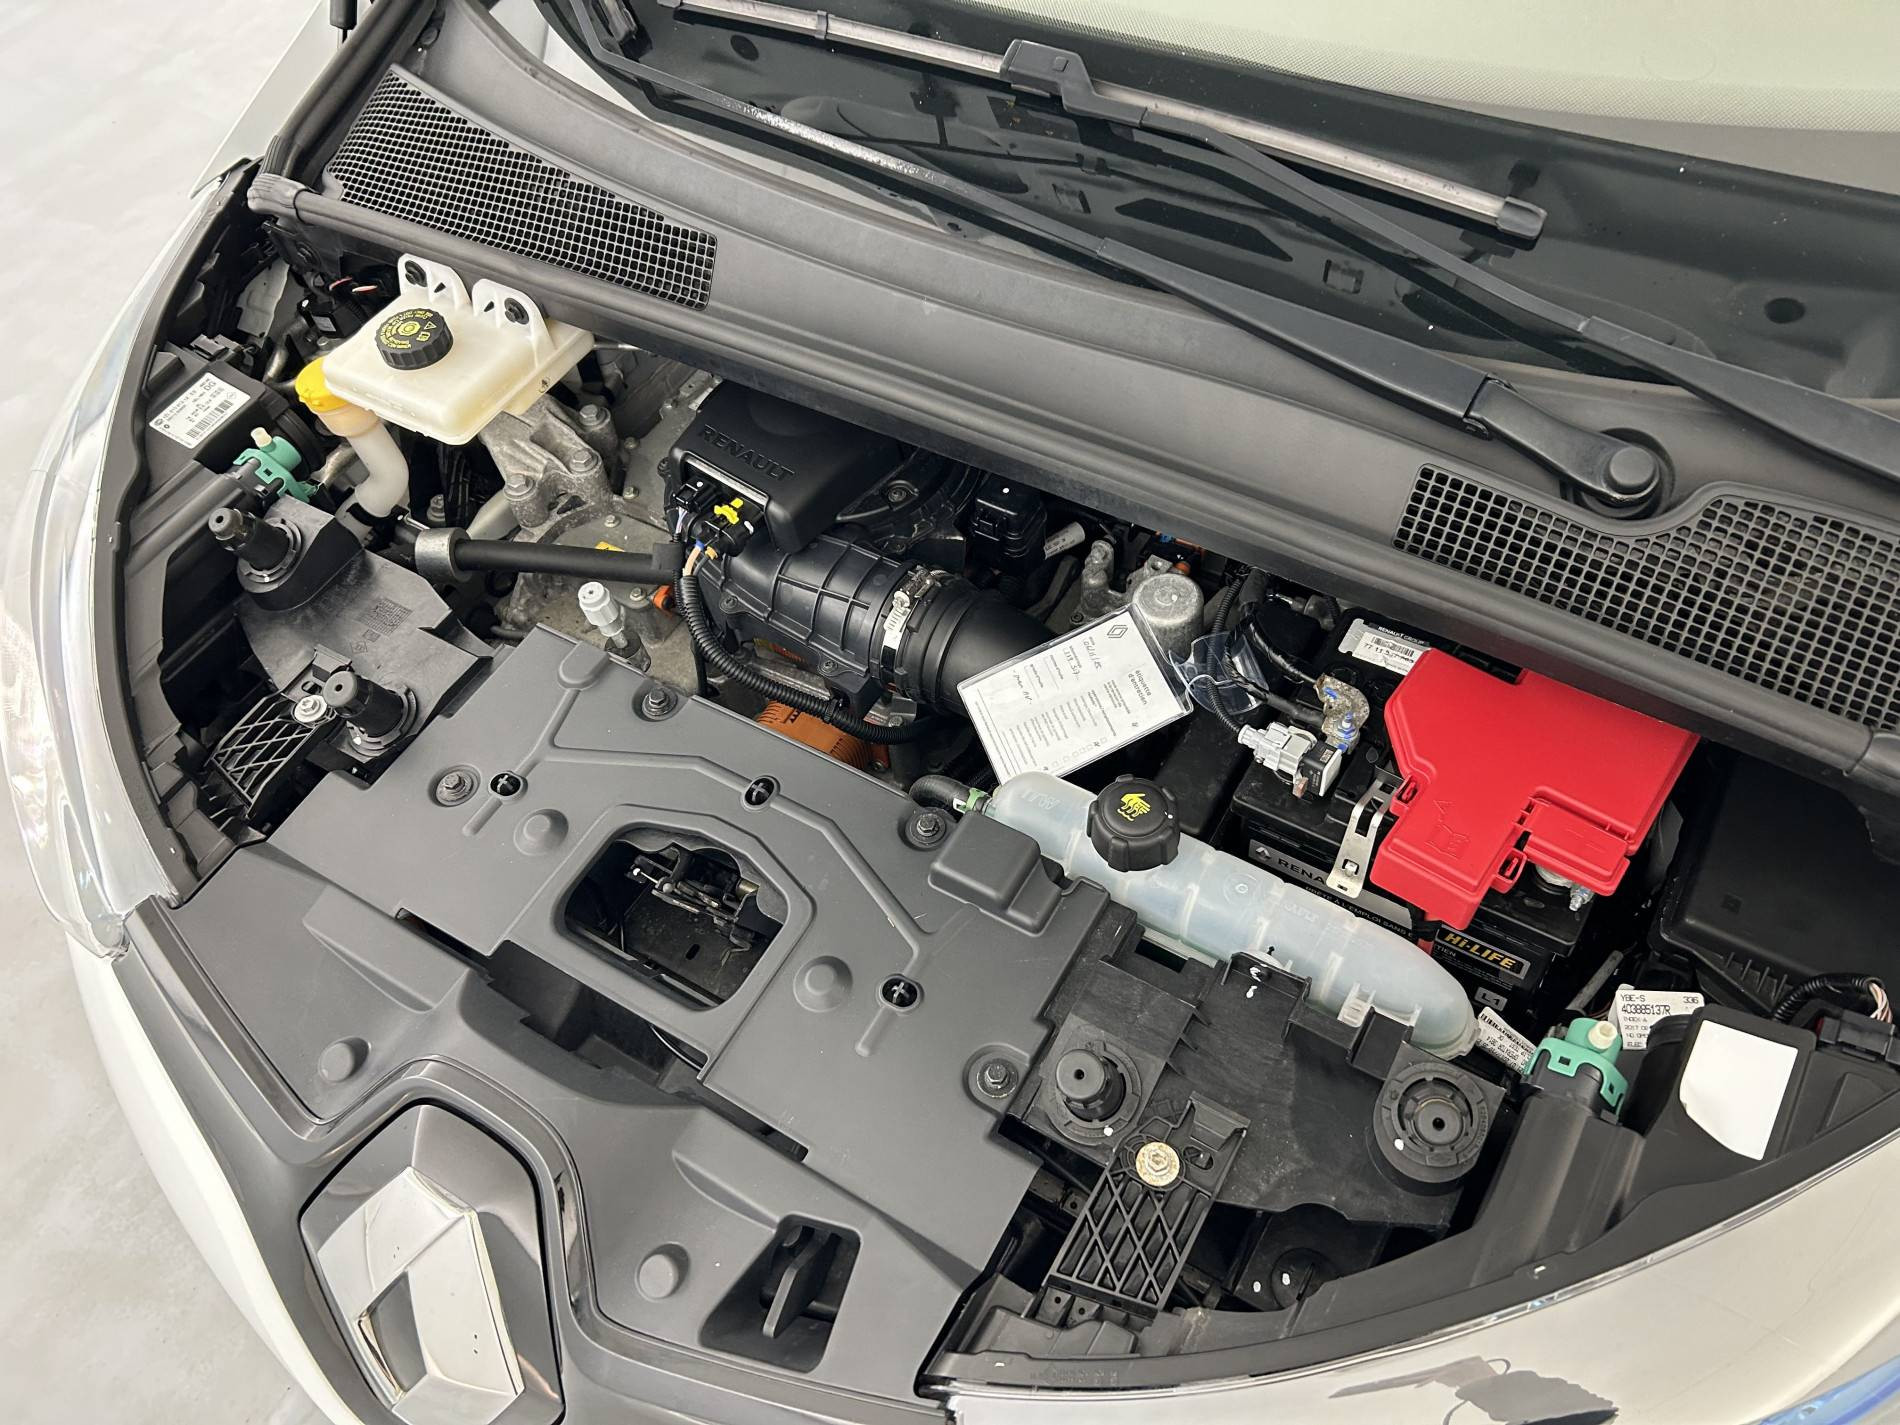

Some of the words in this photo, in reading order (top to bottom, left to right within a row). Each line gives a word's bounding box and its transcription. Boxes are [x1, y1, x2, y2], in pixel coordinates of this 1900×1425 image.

[699, 424, 795, 480] RENAULT
[1276, 858, 1326, 885] RENA
[1443, 932, 1516, 968] Hi-LIFE
[1481, 992, 1500, 1005] L1
